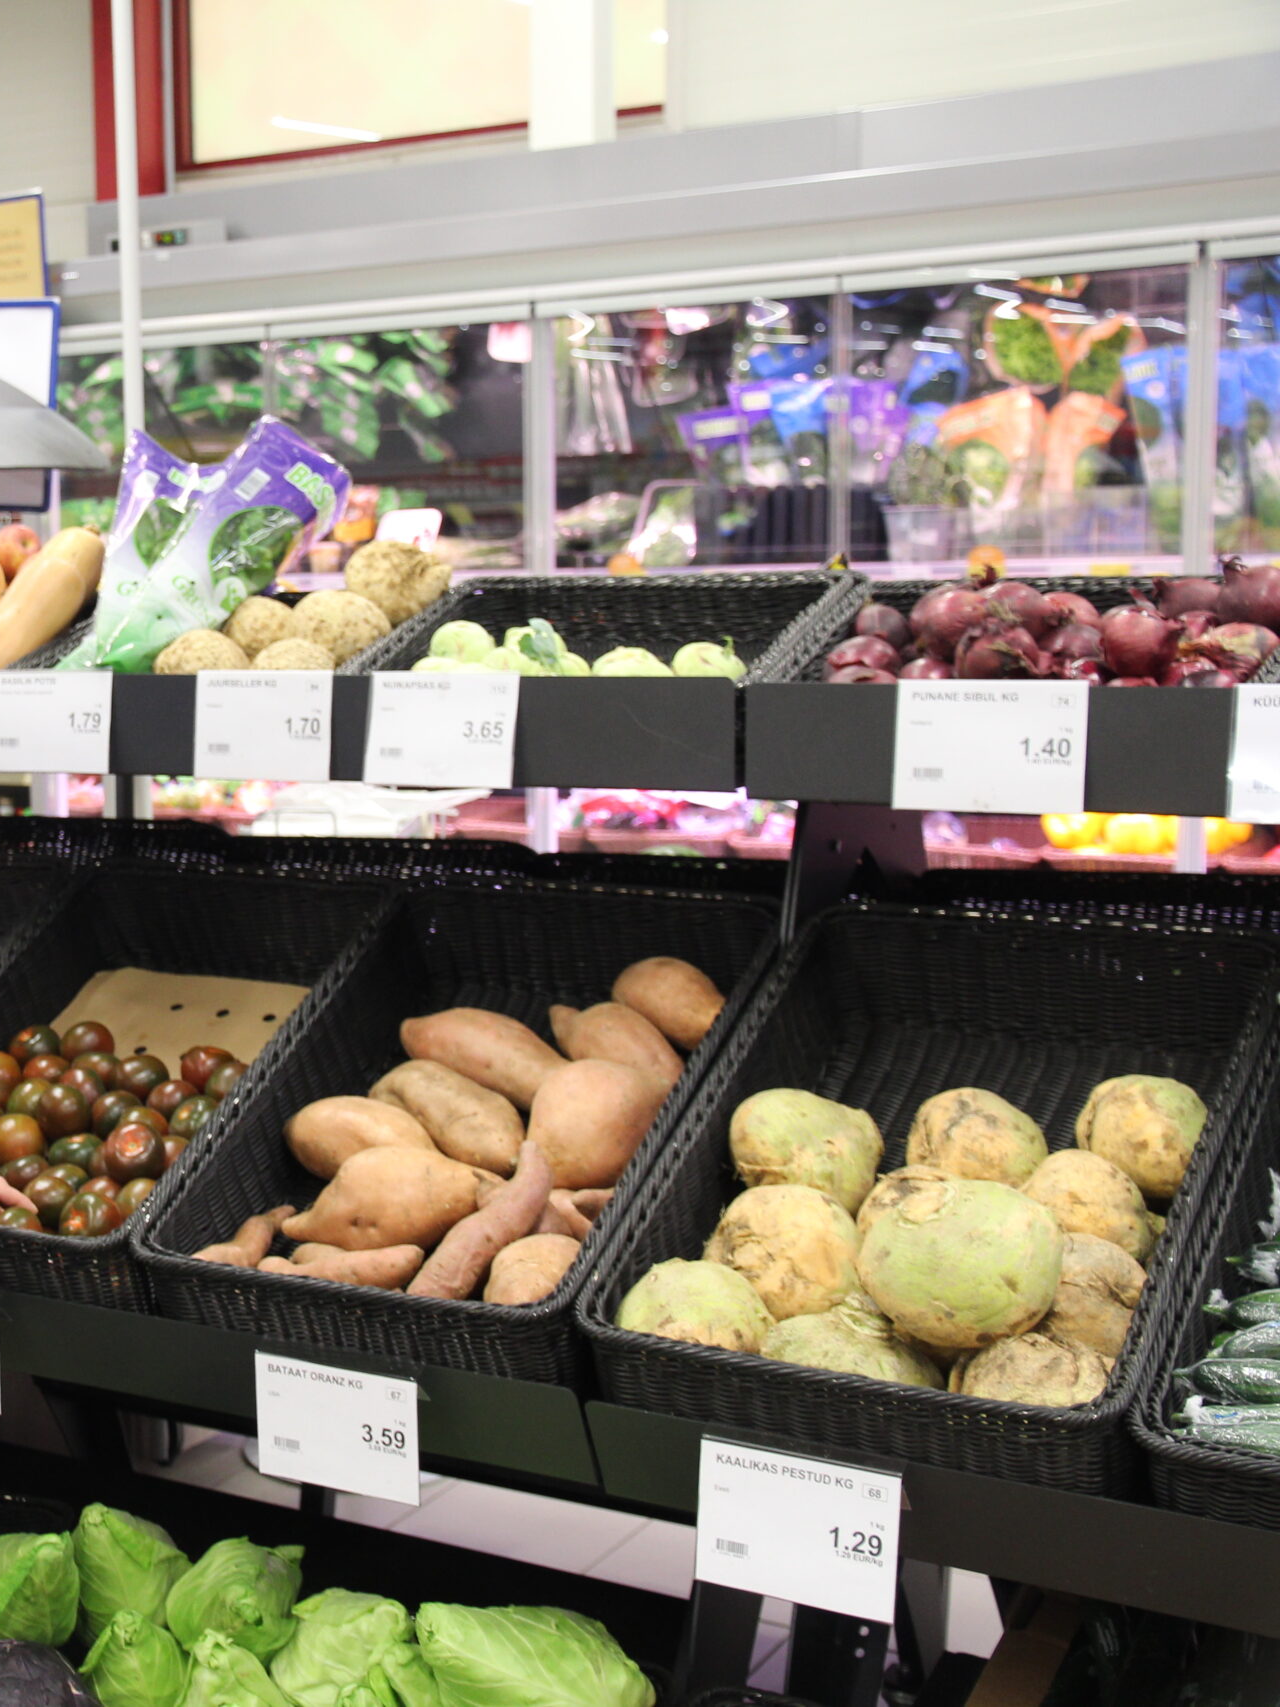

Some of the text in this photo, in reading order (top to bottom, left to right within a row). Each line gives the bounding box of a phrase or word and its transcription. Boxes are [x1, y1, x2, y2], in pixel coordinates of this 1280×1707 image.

[912, 692, 1019, 703] PUNANE SIBUL KG
[68, 712, 102, 730] 1.79
[284, 716, 322, 735] 1.70
[463, 720, 504, 739] 3.65
[1019, 736, 1072, 759] 1.40
[268, 1363, 363, 1390] BATAAT ORANZ KG
[390, 1391, 401, 1400] 67
[361, 1424, 406, 1450] 3.59
[715, 1453, 854, 1490] KAALIKAS PESTUD KG
[868, 1487, 882, 1499] 68
[829, 1526, 884, 1558] 1.29
